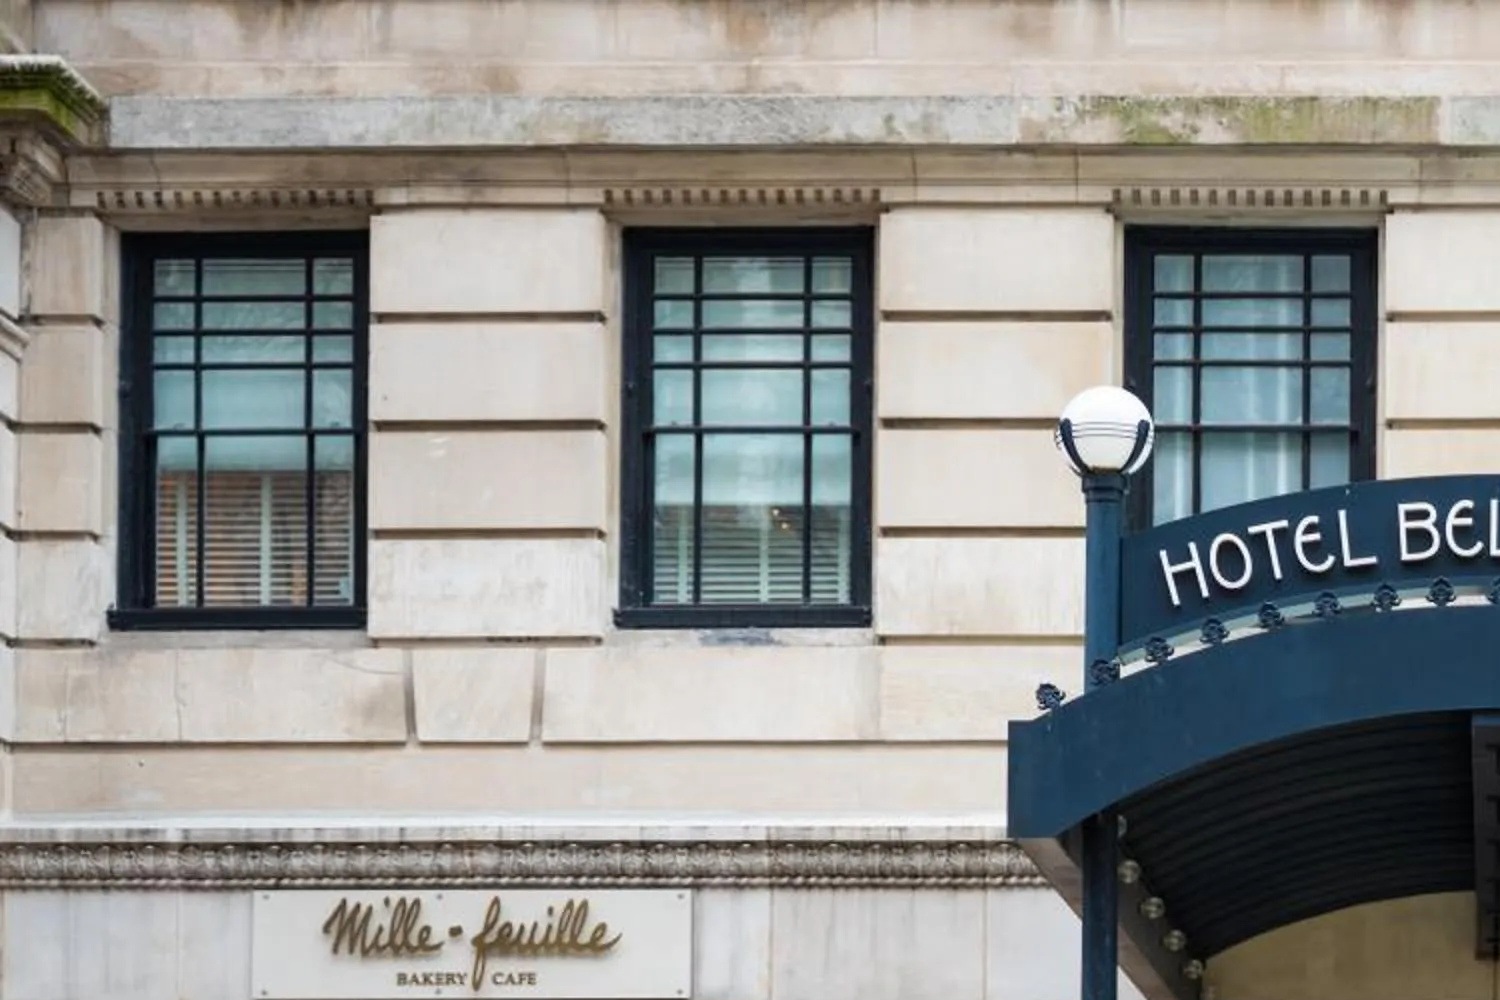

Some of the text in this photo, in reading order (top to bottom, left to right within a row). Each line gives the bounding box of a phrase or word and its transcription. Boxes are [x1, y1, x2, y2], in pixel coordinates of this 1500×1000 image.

[1159, 508, 1378, 606] HOTEL
[396, 971, 537, 987] BAKERY CAFE
